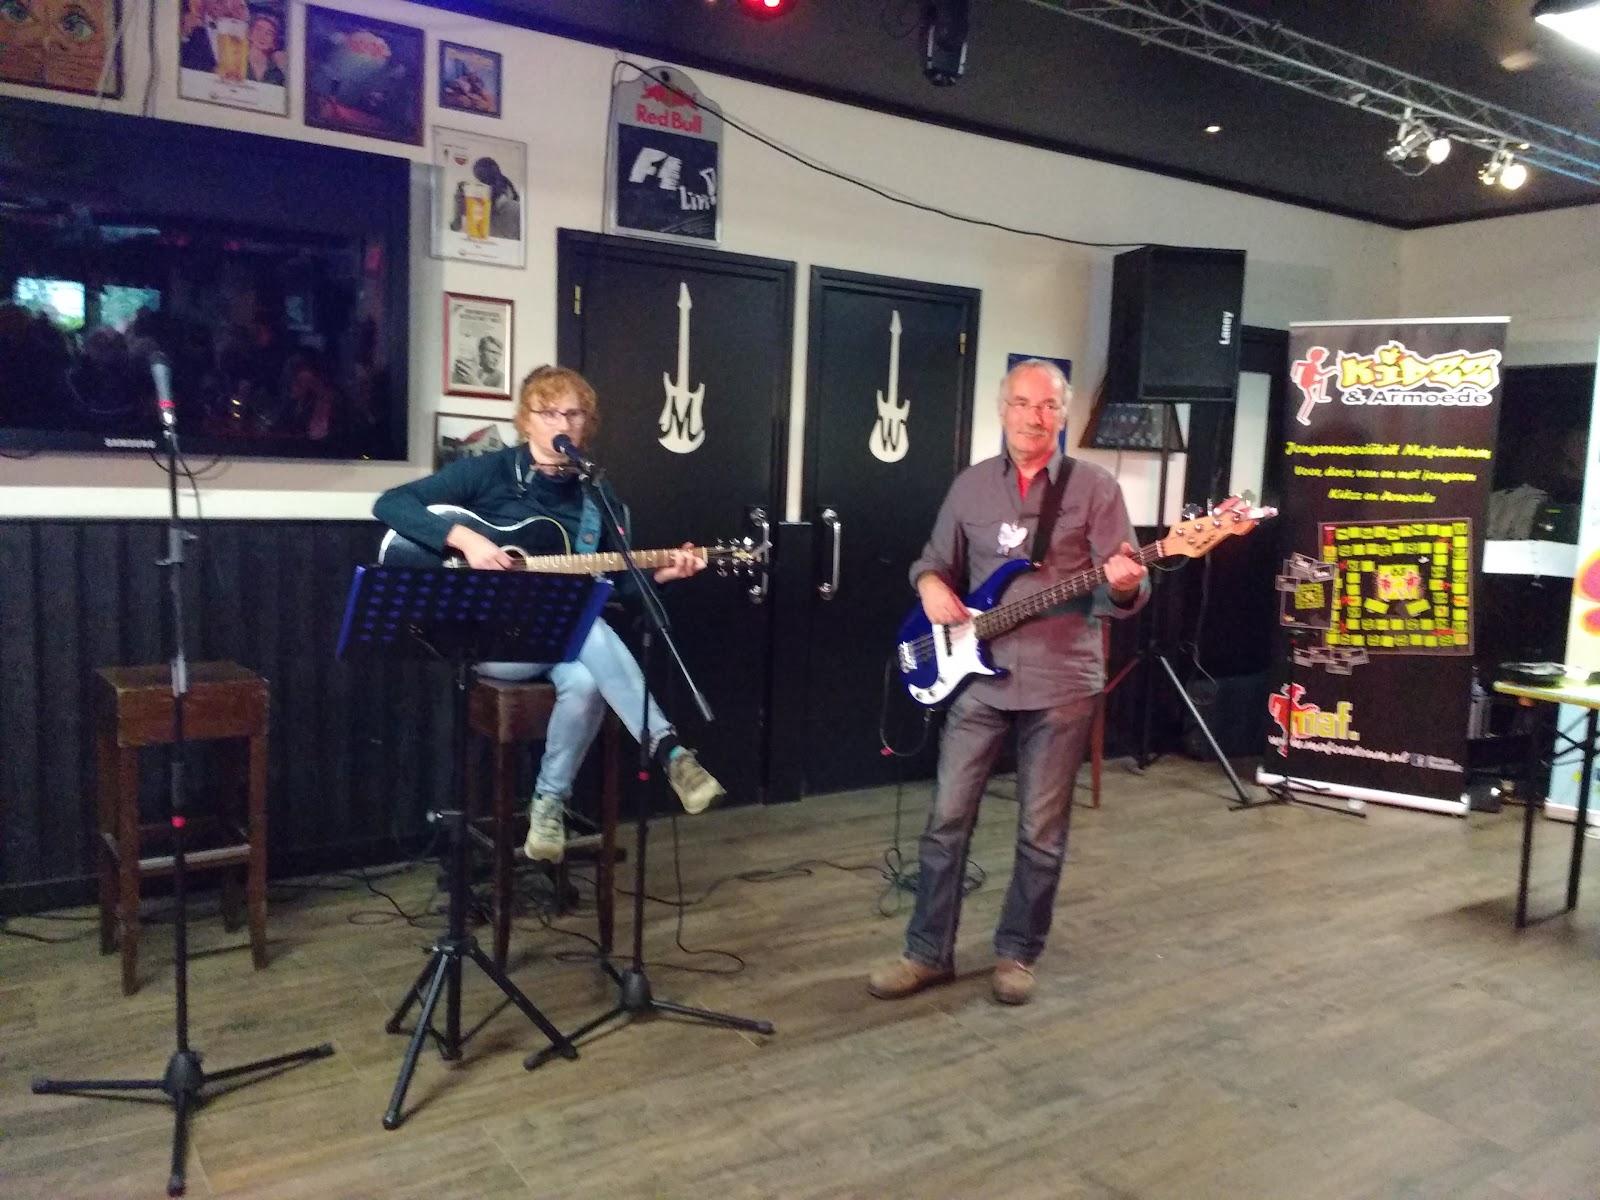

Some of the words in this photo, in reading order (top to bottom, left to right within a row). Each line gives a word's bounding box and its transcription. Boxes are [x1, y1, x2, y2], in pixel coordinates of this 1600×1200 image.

[635, 104, 668, 127] Red
[672, 112, 702, 134] Bull
[1219, 311, 1234, 345] Laney
[1371, 391, 1488, 404] Armoede
